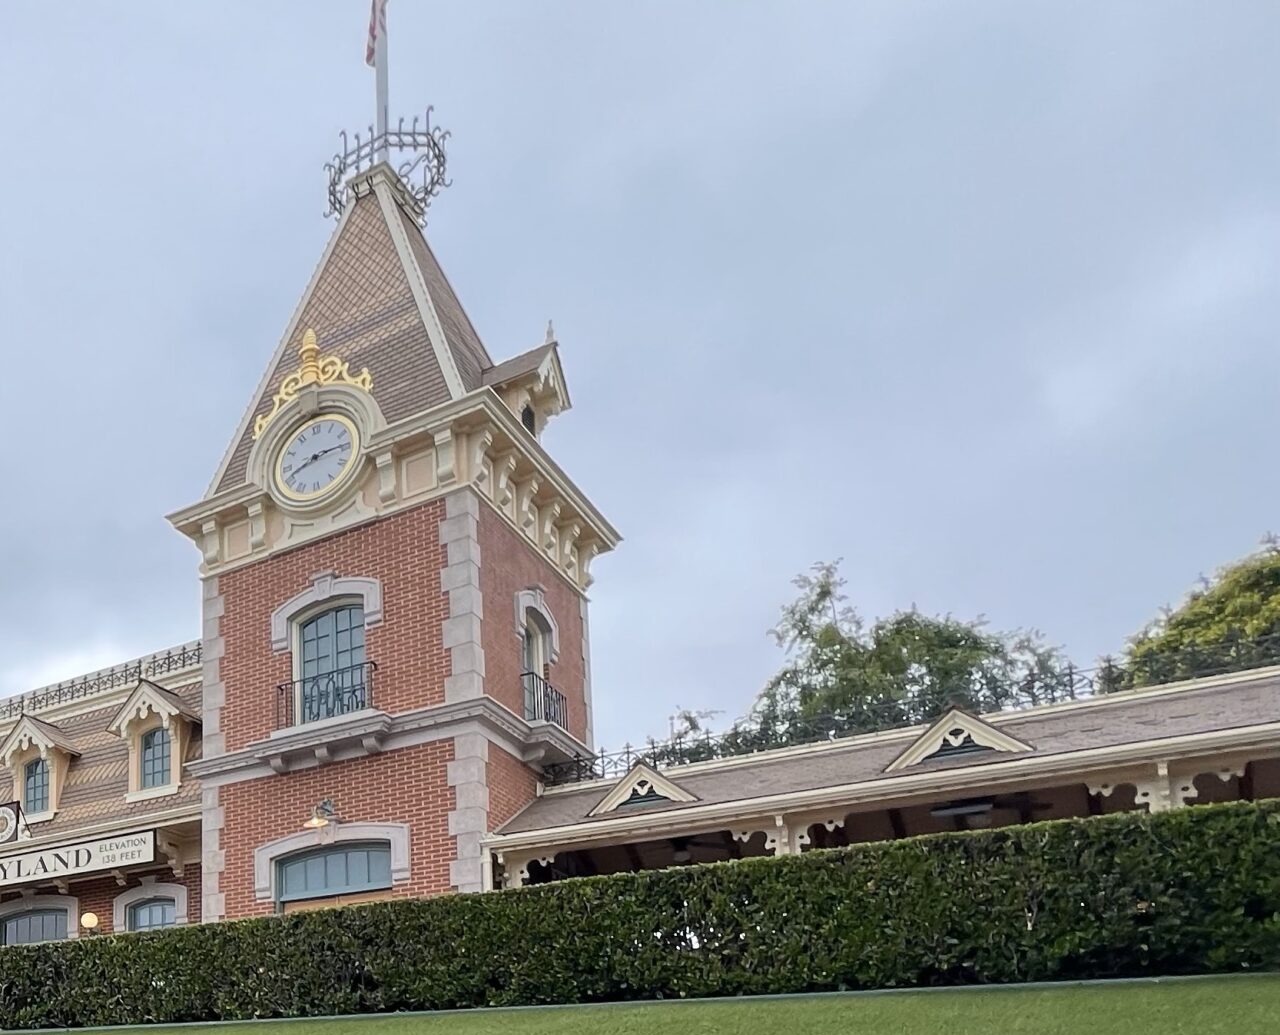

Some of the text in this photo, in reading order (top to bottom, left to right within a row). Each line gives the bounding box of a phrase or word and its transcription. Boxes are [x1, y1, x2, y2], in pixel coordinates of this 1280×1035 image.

[99, 836, 147, 853] ELEVATION
[102, 849, 143, 865] 138 FEET
